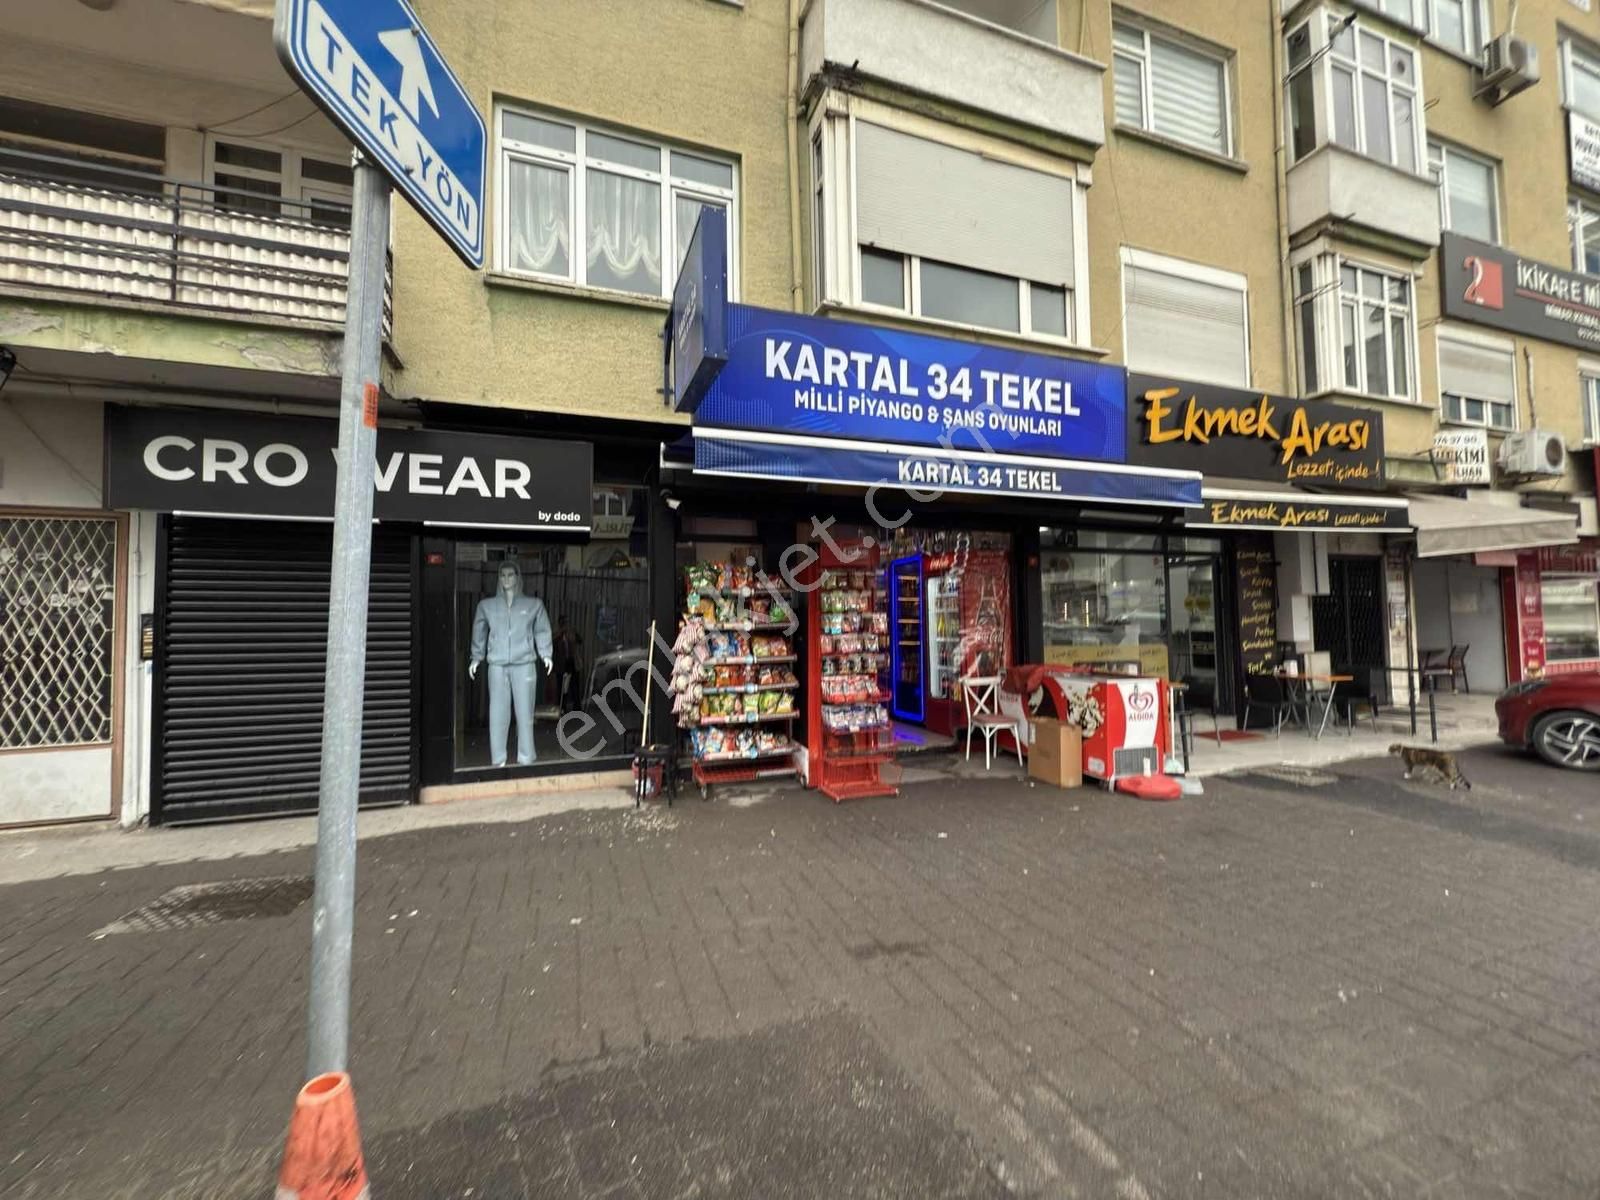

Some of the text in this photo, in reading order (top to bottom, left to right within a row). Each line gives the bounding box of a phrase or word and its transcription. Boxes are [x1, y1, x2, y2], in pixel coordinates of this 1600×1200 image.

[320, 23, 470, 233] TEK YÖN
[765, 338, 1081, 416] KARTAL 34 TEKEL
[794, 386, 1062, 437] MİLLİ PİYANGO & ŞANS OYUNLARI
[1145, 387, 1370, 464] Ekmek Arası
[143, 435, 309, 487] CRO
[898, 460, 1062, 491] KARTAL 34 TEKEL
[1287, 458, 1335, 479] Lezzeti
[538, 511, 581, 521] by dodo
[1211, 502, 1329, 528] Ekmek Arası
